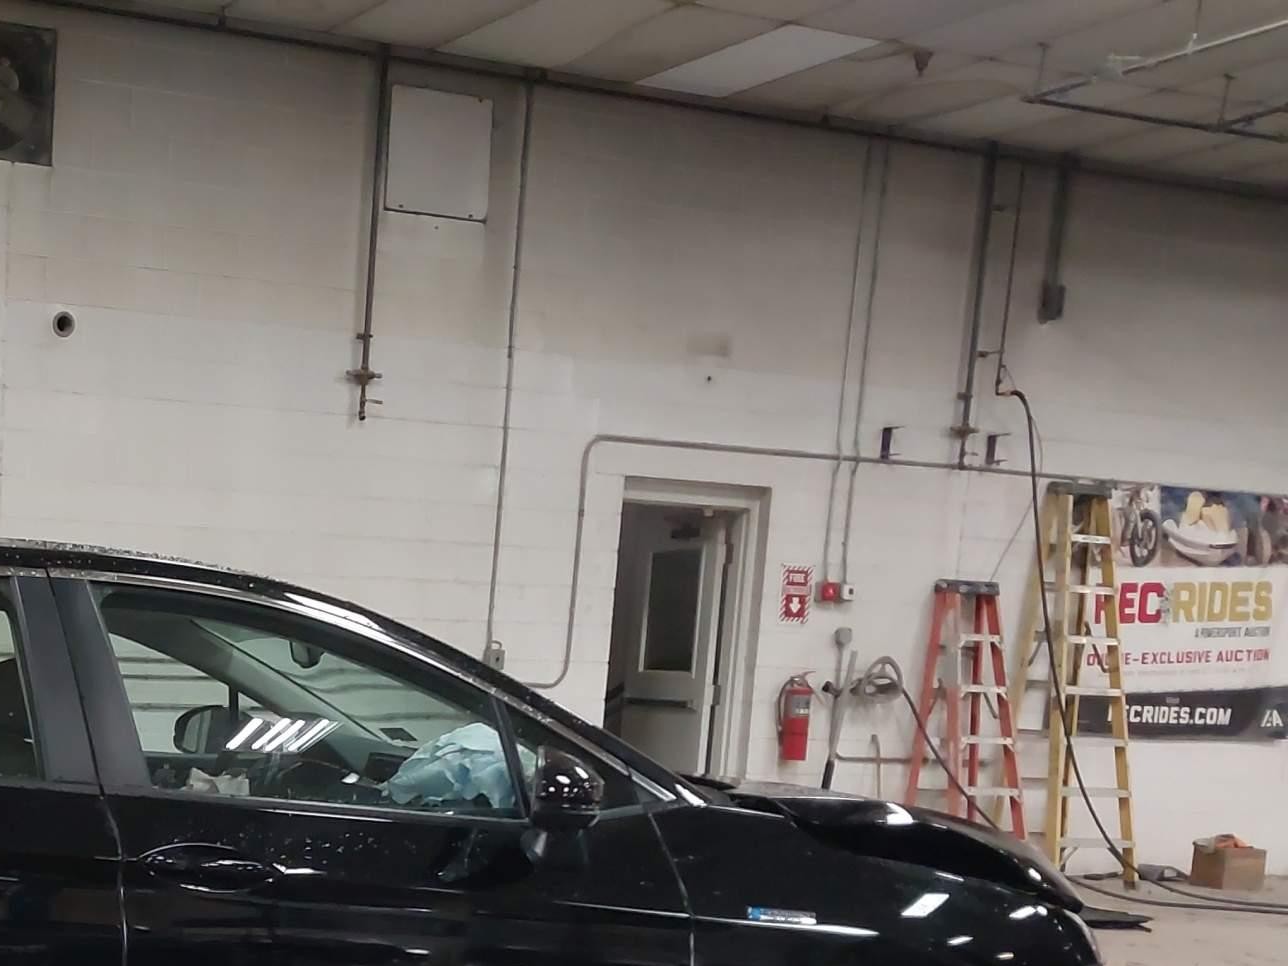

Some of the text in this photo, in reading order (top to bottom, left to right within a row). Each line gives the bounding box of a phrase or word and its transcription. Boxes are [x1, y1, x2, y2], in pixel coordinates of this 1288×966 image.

[1171, 581, 1273, 623] RIDES
[1086, 648, 1270, 667] OE-EXCLUSIVE AUCTION
[1107, 703, 1232, 726] CRIDES.COM
